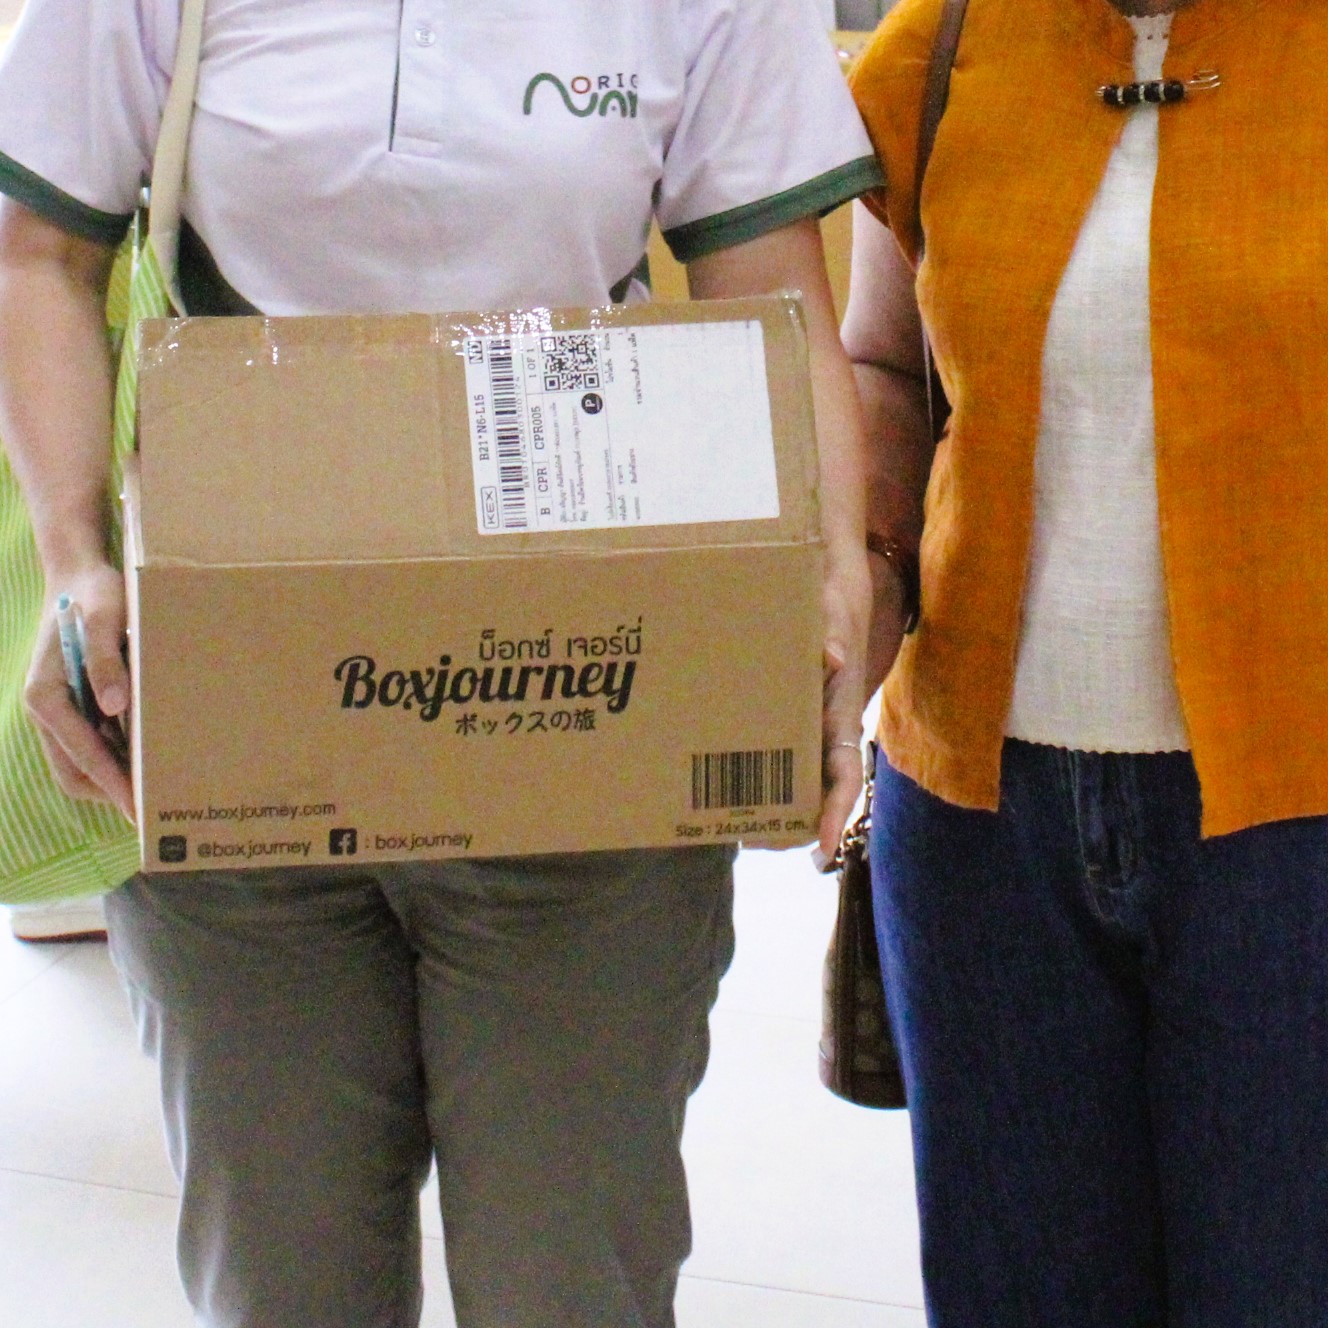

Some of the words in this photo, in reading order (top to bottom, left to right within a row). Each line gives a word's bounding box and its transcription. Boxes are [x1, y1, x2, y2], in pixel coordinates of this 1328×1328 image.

[527, 356, 537, 371] OF
[531, 406, 546, 451] CPR005
[536, 467, 549, 493] CPR
[540, 507, 551, 516] B
[478, 628, 554, 661] บ็อกซ์
[566, 615, 643, 658] เจอร์นี่
[333, 654, 637, 722] Boxjourney
[455, 708, 597, 736] ボックスの旅
[158, 803, 337, 822] www.boxjourney.com
[197, 839, 312, 859] @boxjourney
[374, 832, 473, 852] boxjourney
